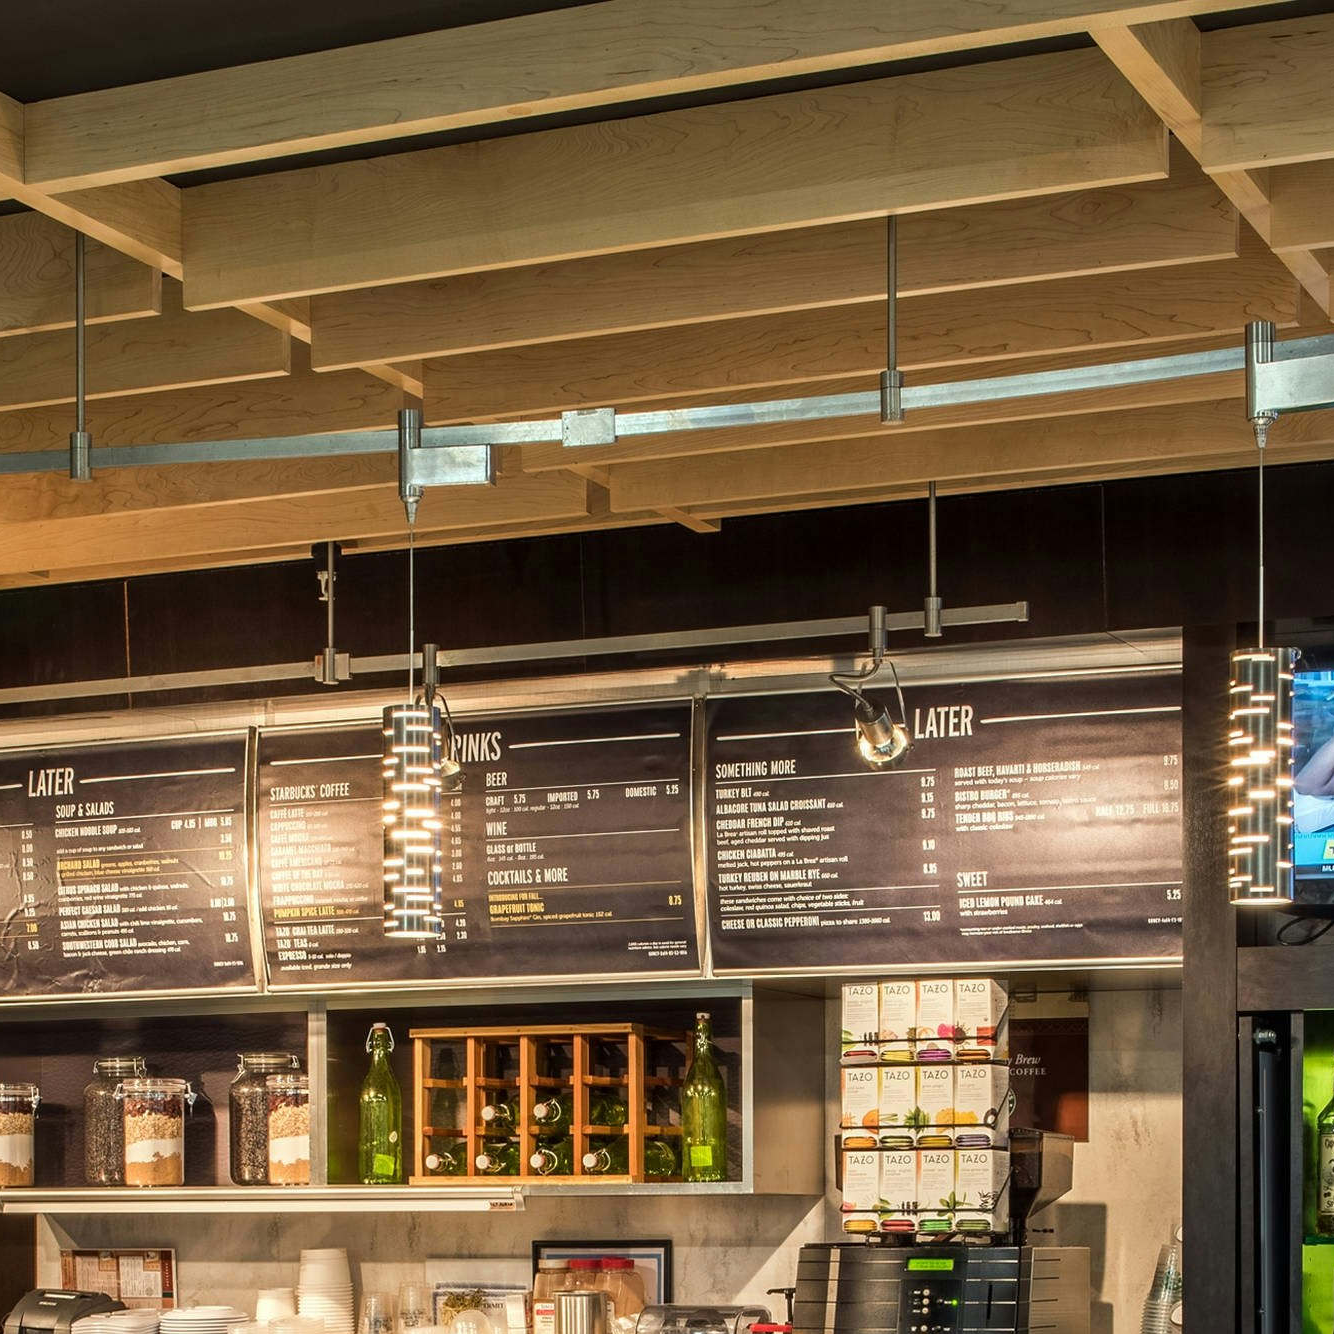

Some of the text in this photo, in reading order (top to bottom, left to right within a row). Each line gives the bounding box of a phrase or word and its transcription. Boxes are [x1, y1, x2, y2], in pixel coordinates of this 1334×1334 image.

[914, 705, 973, 740] LATER
[448, 730, 502, 763] RINKS
[715, 760, 796, 779] SOMETHING MORE
[954, 767, 977, 778] ROAST
[996, 764, 1024, 776] HAVARTI
[1033, 761, 1081, 774] HORSERADISH
[28, 767, 74, 798] LATER
[486, 772, 507, 787] BEER
[319, 782, 350, 798] COFFEE
[486, 784, 679, 807] CRAFT 5.75 IMPORTED 5.75 DOMESTIC 5.25
[716, 788, 740, 799] TURKEY
[741, 787, 752, 798] BLT
[955, 791, 979, 802] BISTRO
[55, 801, 115, 819] SOUP & SALADS
[716, 799, 826, 815] ALBACORE TUNA SALAD CROISSANT
[486, 821, 507, 836] WINE
[716, 816, 785, 830] CHEDDAR FRENCH DIP
[55, 826, 78, 838] CHICKEN
[486, 844, 505, 855] GLASS
[515, 842, 536, 853] BOTTLE
[717, 848, 777, 861] CHICKEN CIABATTA
[487, 867, 568, 885] COCKTAILS & MORE
[719, 868, 820, 884] TURKEY REUBEN ON MARBLE RYE
[956, 871, 988, 887] SWEET
[489, 895, 682, 915] GRAPEFRUIT TONIC 8.75
[959, 889, 1181, 909] ICED LEMON POUND CAKE 5.25
[721, 919, 745, 930] CHEESE
[746, 918, 755, 928] OR
[756, 917, 783, 928] CLASSIC
[784, 916, 819, 927] PEPPERONI
[848, 987, 873, 996] TAZO
[884, 985, 910, 995] TAZO
[922, 984, 948, 993] TAZO
[959, 983, 985, 993] TAZO
[1015, 1054, 1041, 1066] Brew
[847, 1072, 873, 1082] TAZO
[884, 1071, 910, 1080] TAZO
[922, 1070, 948, 1080] TAZO
[960, 1069, 987, 1079] TAZO
[1009, 1068, 1047, 1076] COFFEE
[848, 1155, 874, 1165] TAZO
[885, 1155, 912, 1164] TAZO
[923, 1154, 949, 1164] TAZO
[961, 1154, 987, 1163] TAZO
